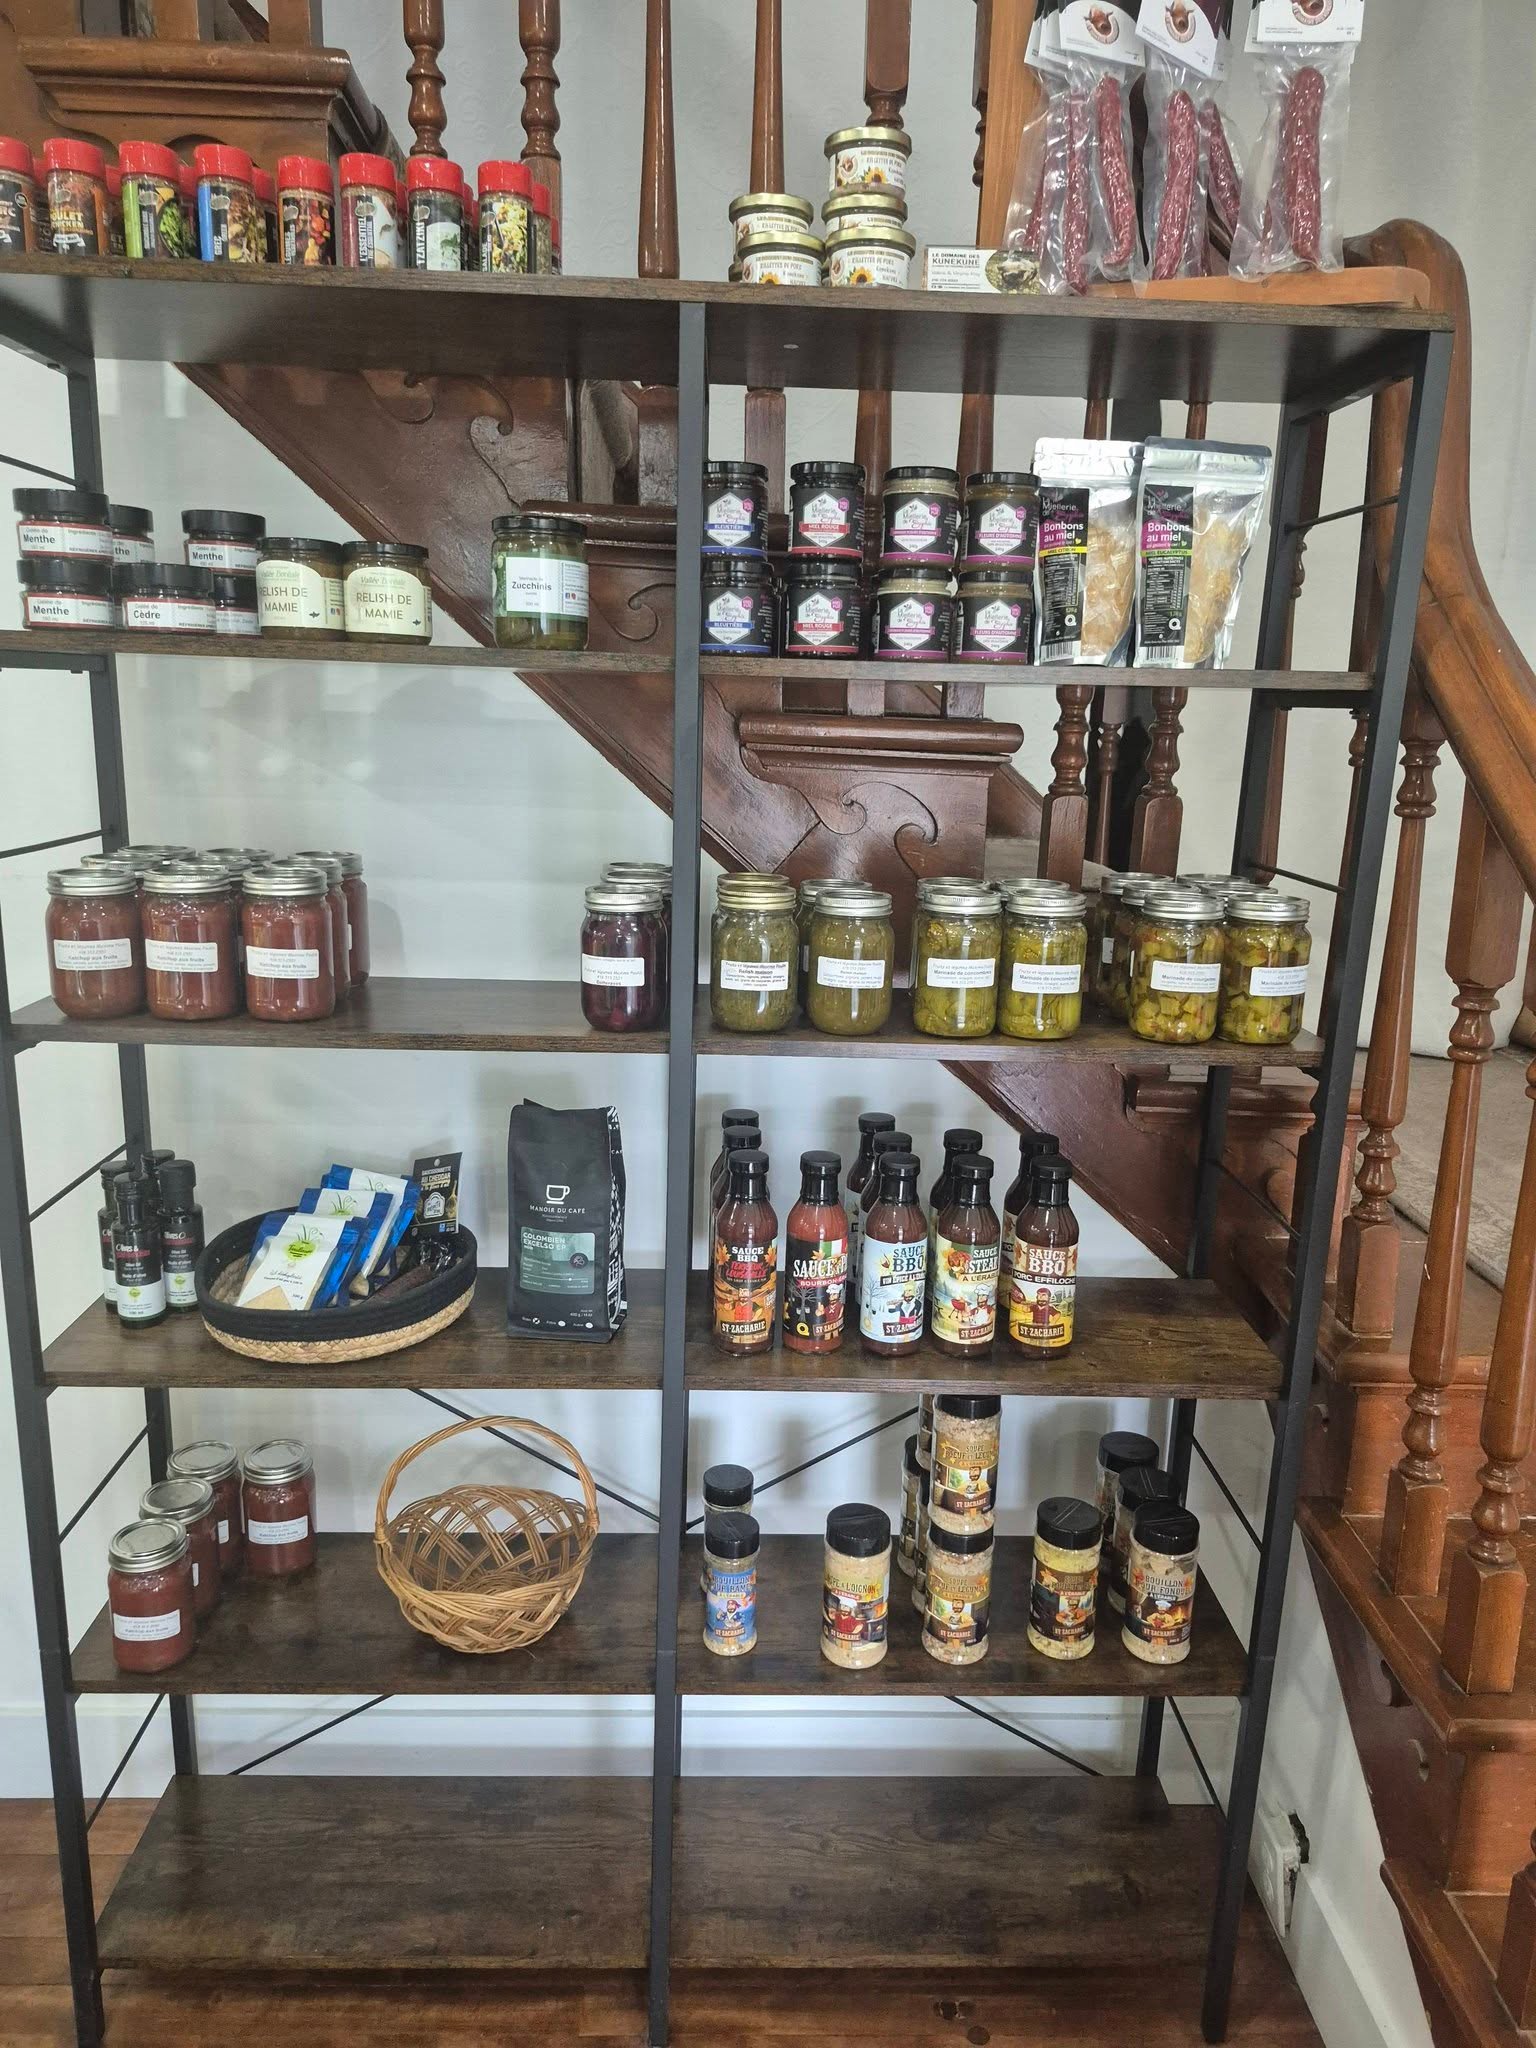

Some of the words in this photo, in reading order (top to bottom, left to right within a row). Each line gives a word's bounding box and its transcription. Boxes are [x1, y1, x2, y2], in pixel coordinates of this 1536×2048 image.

[416, 221, 425, 264] TZATZIKI
[932, 258, 978, 266] KUNEKUNE
[1043, 521, 1084, 533] Bonbons
[1147, 522, 1190, 533] Bonbons
[23, 534, 56, 544] Menthe
[1044, 534, 1054, 543] au
[1056, 530, 1076, 540] miel
[1146, 534, 1159, 543] au
[1160, 531, 1182, 541] miel
[115, 546, 130, 556] the
[192, 551, 224, 561] Menthe
[511, 581, 552, 591] Zucchinis
[291, 587, 308, 597] DE
[356, 592, 394, 604] RELISH
[397, 594, 412, 605] DE
[33, 605, 70, 616] Menthe
[264, 602, 298, 612] MAMIE
[133, 610, 161, 619] Cèdre
[365, 608, 404, 620] MAMIE
[428, 1173, 451, 1182] CHEDDAR
[529, 1204, 555, 1213] MANOIR
[522, 1232, 566, 1244] COLOMBIEN
[523, 1238, 555, 1250] EXCELSO
[1003, 1244, 1013, 1252] PO
[731, 1246, 764, 1255] SAUCE
[1029, 1248, 1066, 1261] SAUCE
[737, 1254, 758, 1262] BBQ
[793, 1259, 834, 1278] SAUCE
[1028, 1259, 1066, 1276] BBQ
[1014, 1273, 1033, 1282] PORC
[722, 1321, 766, 1334] ST-ZACHARIE
[1020, 1325, 1064, 1337] ST-ZACHARIE
[712, 1576, 751, 1585] BOUILLON
[1145, 1575, 1184, 1588] BOUILLON
[846, 1582, 876, 1594] L'OIGNON
